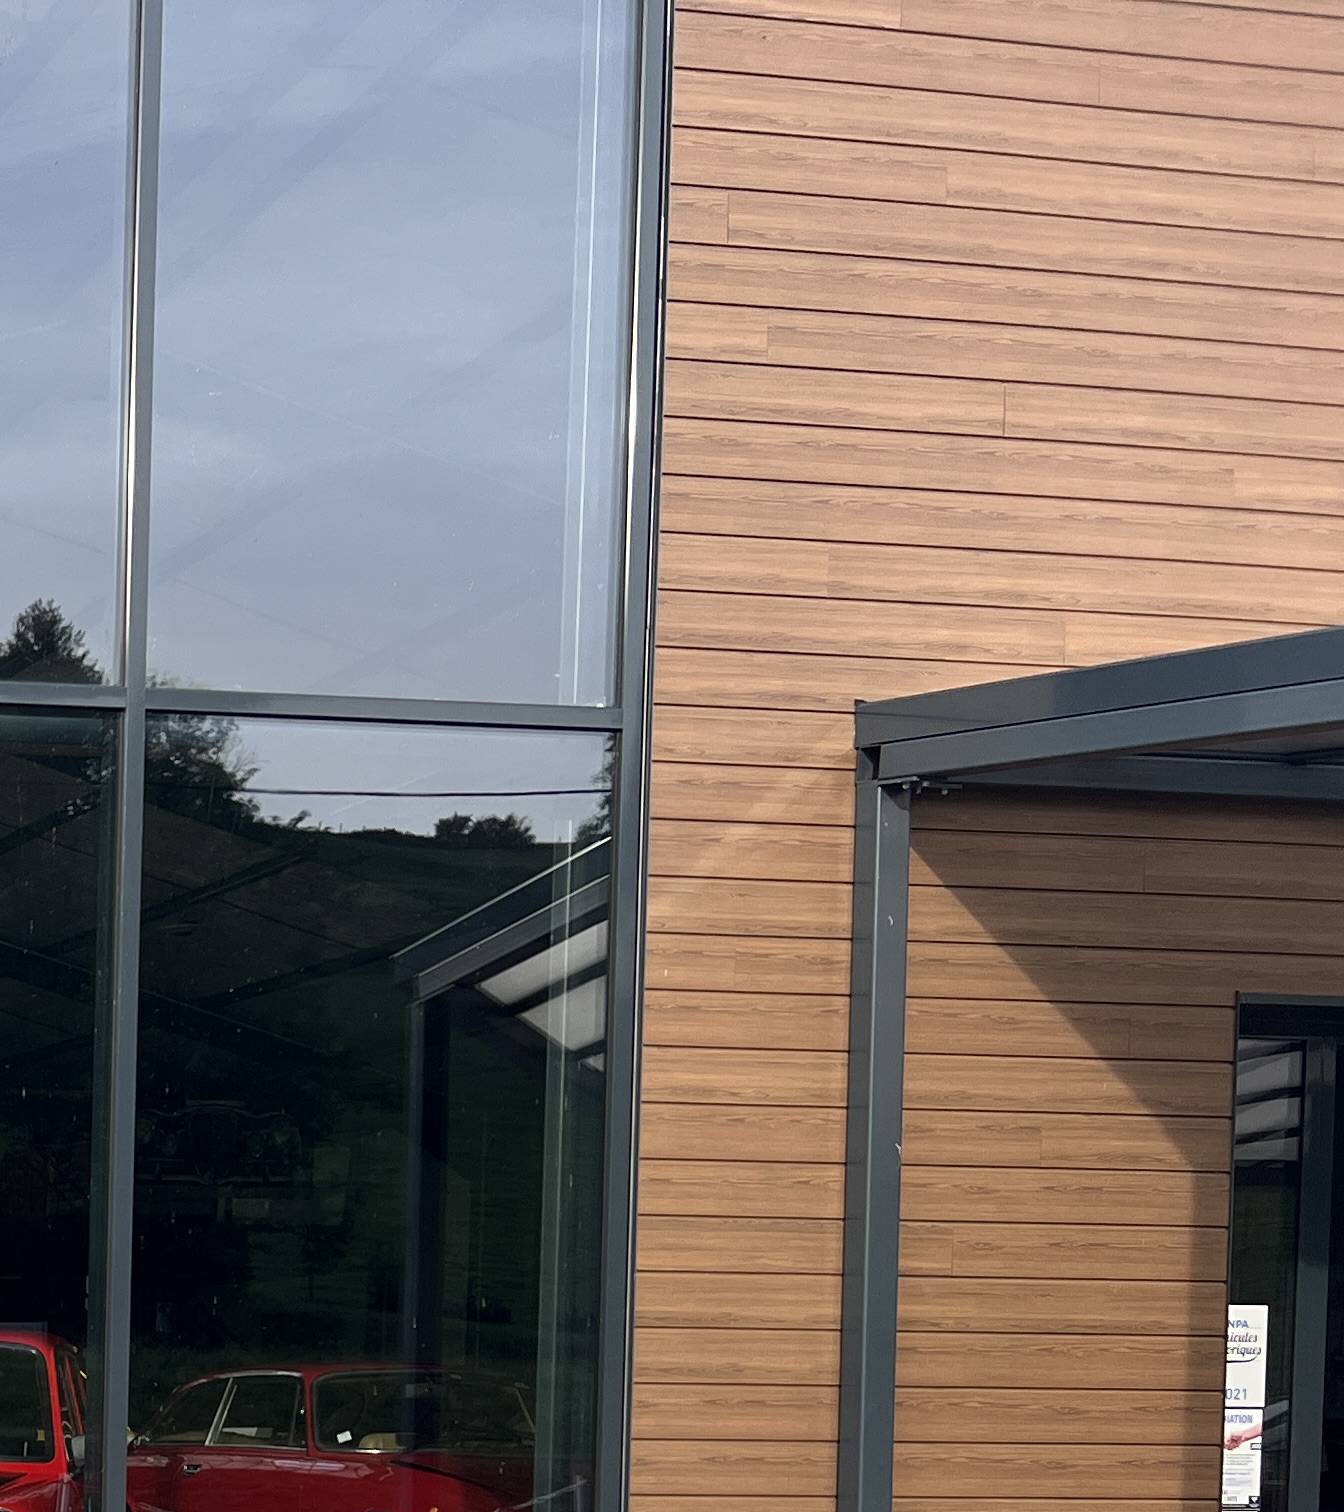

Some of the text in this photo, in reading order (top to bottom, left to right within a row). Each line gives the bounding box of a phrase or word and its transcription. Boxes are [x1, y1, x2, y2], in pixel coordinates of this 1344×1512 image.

[1228, 1319, 1249, 1329] NPA
[1226, 1332, 1258, 1343] icules
[1225, 1388, 1247, 1400] 021
